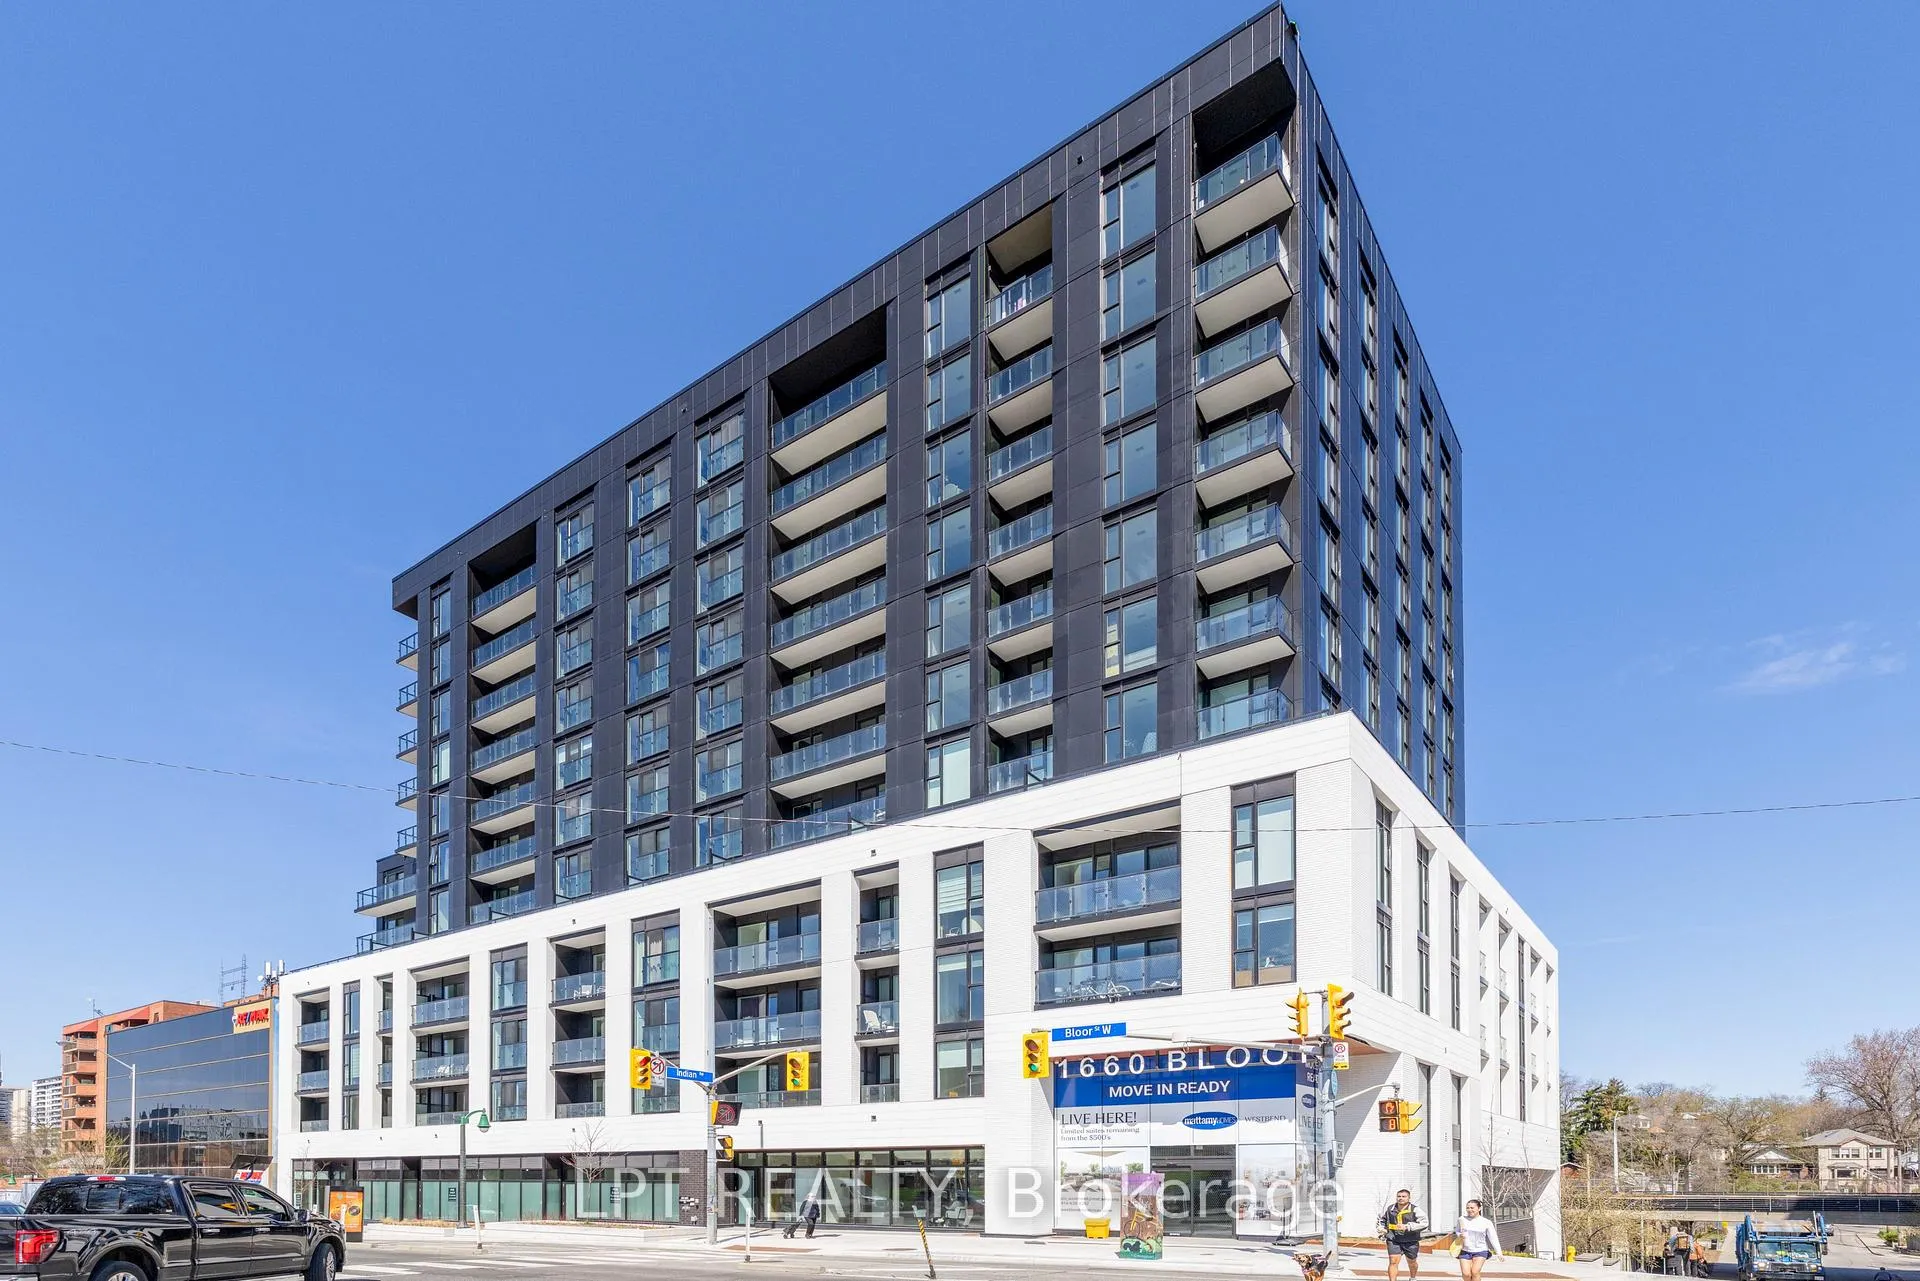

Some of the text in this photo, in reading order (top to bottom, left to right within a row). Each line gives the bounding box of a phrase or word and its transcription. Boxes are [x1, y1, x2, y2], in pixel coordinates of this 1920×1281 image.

[1064, 1028, 1094, 1038] Bloor
[1102, 1024, 1112, 1035] W
[1057, 1046, 1307, 1079] 1660 BLOO
[676, 1069, 698, 1079] Indian
[1109, 1080, 1231, 1098] MOVE IN READY
[1061, 1111, 1137, 1125] LIVE HERE!
[1106, 1126, 1140, 1134] remaining
